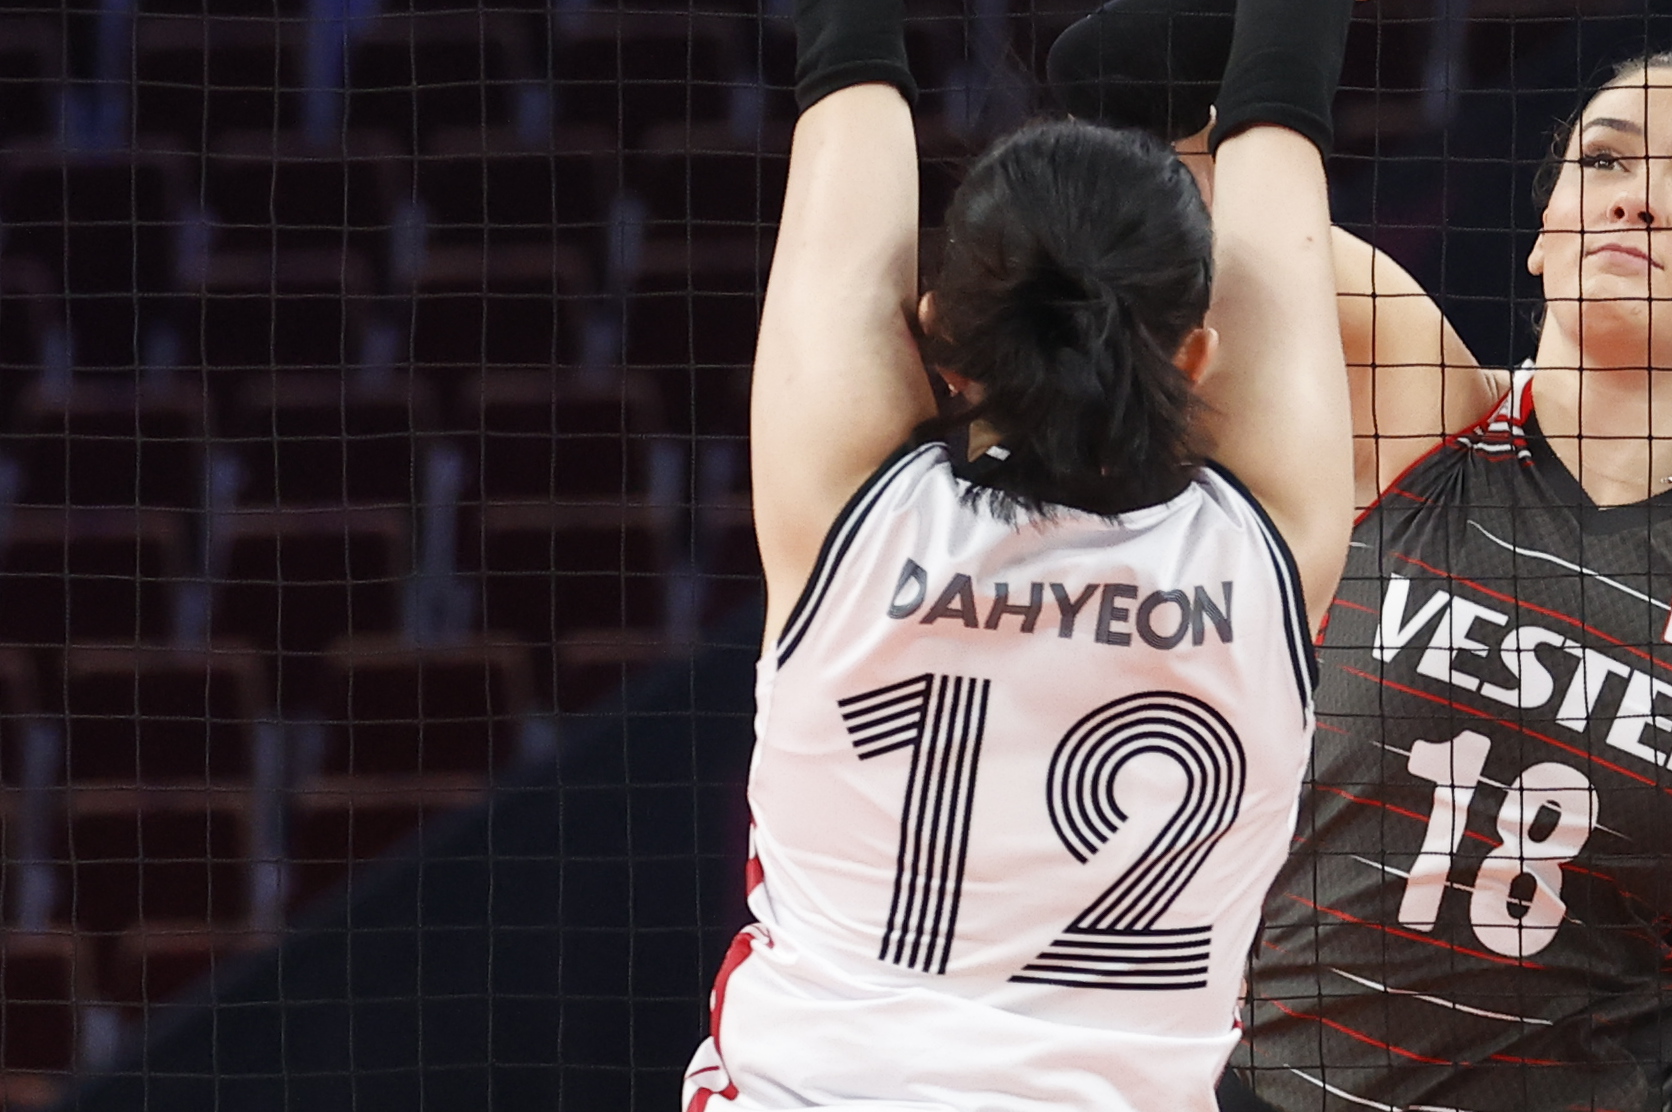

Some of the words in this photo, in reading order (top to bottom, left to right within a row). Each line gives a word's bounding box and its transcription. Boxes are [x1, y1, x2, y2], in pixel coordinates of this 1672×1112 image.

[886, 557, 1235, 650] DAHYEON
[837, 673, 1247, 990] 12
[1398, 729, 1600, 958] 18
